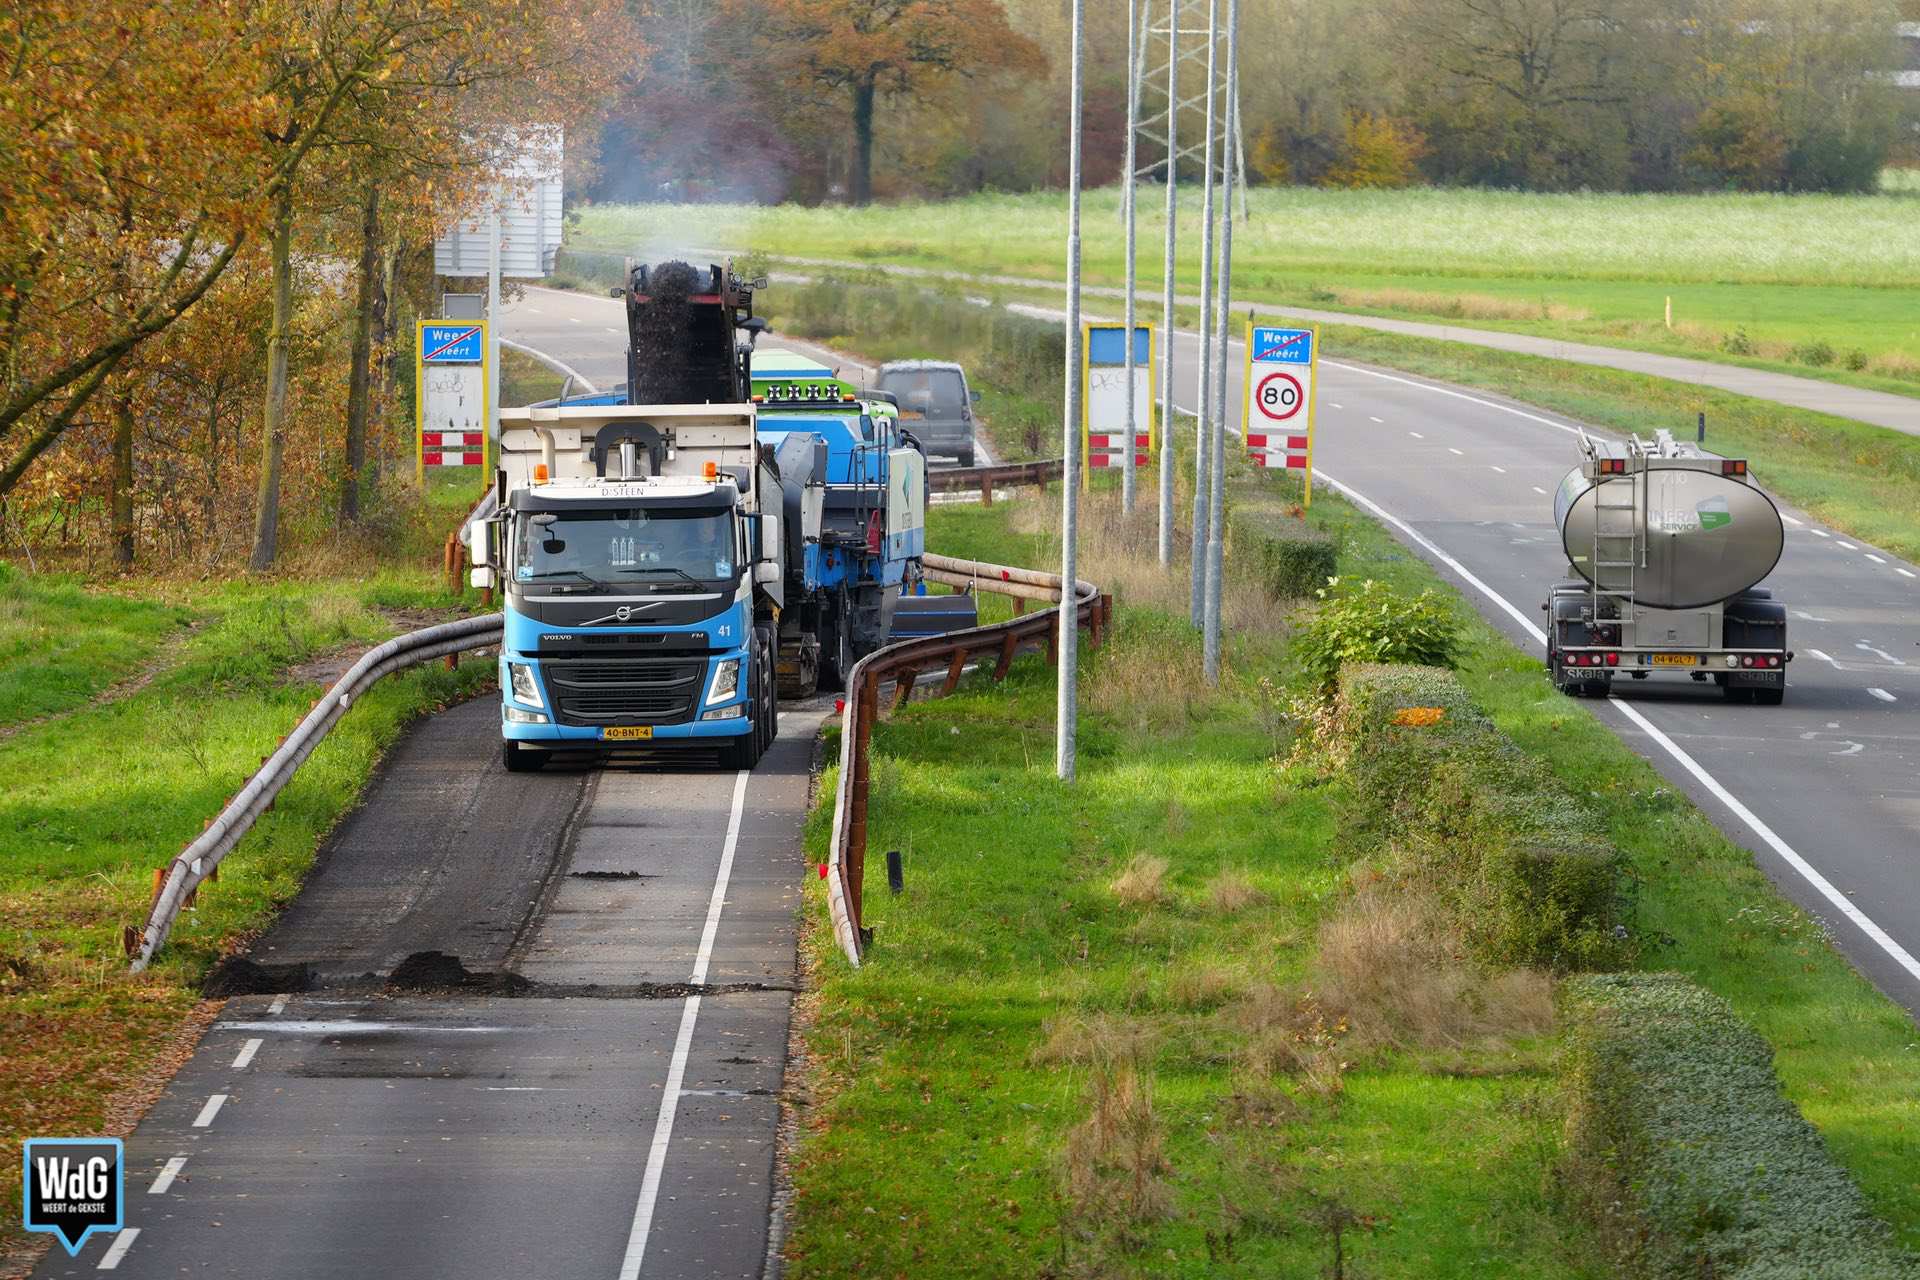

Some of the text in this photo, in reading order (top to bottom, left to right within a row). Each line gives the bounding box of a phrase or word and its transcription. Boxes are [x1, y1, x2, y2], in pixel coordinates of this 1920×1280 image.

[1263, 332, 1302, 344] Weert
[1264, 387, 1296, 405] 80
[1660, 523, 1698, 531] SERVICE
[718, 625, 730, 637] 41
[606, 728, 650, 737] 40-BNT-4
